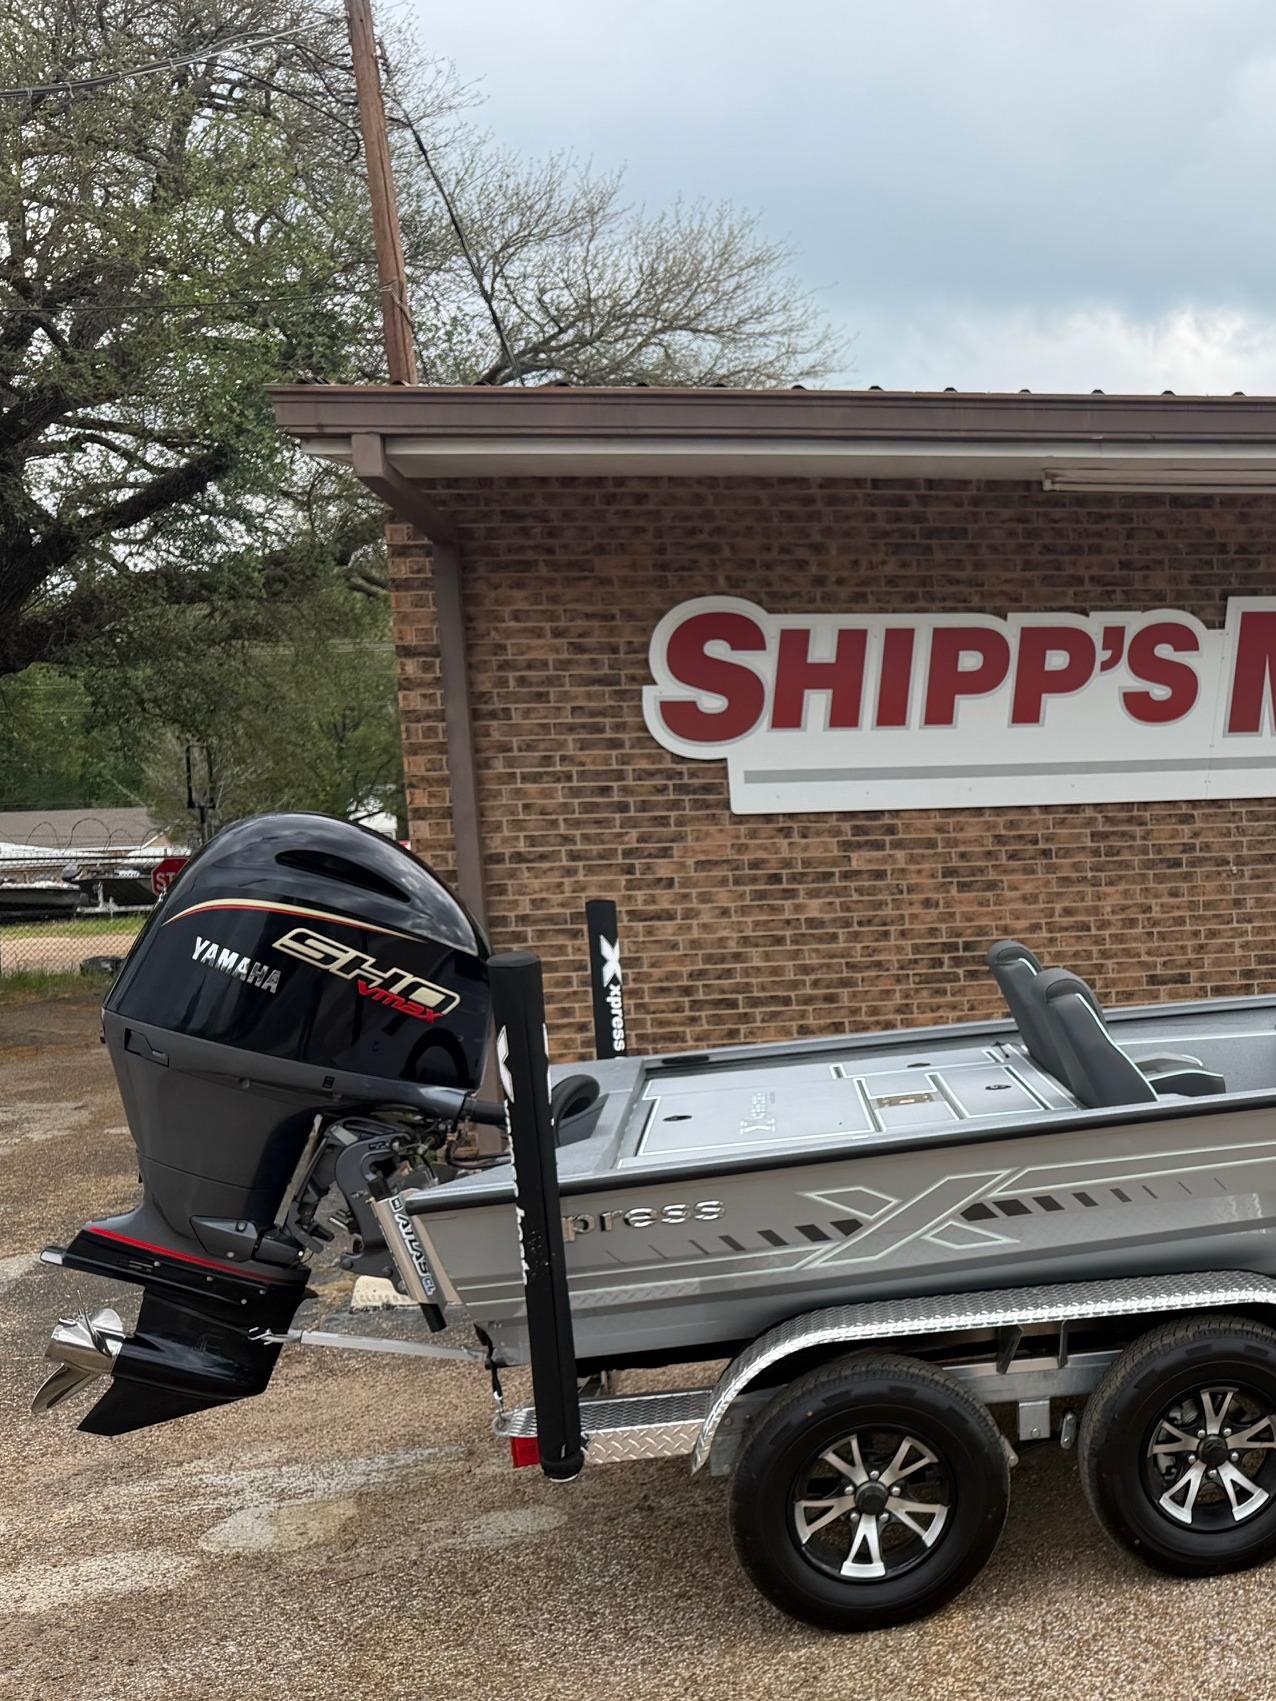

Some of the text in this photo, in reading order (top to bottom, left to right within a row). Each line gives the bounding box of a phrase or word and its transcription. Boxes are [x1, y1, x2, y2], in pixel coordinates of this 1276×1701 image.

[659, 611, 1200, 743] SHIPP'S
[155, 871, 177, 891] ST
[191, 935, 283, 995] YAMAHA
[272, 927, 462, 1017] SHO
[606, 983, 626, 1052] xpress
[394, 1213, 429, 1277] ATLAS
[561, 1200, 726, 1243] press
